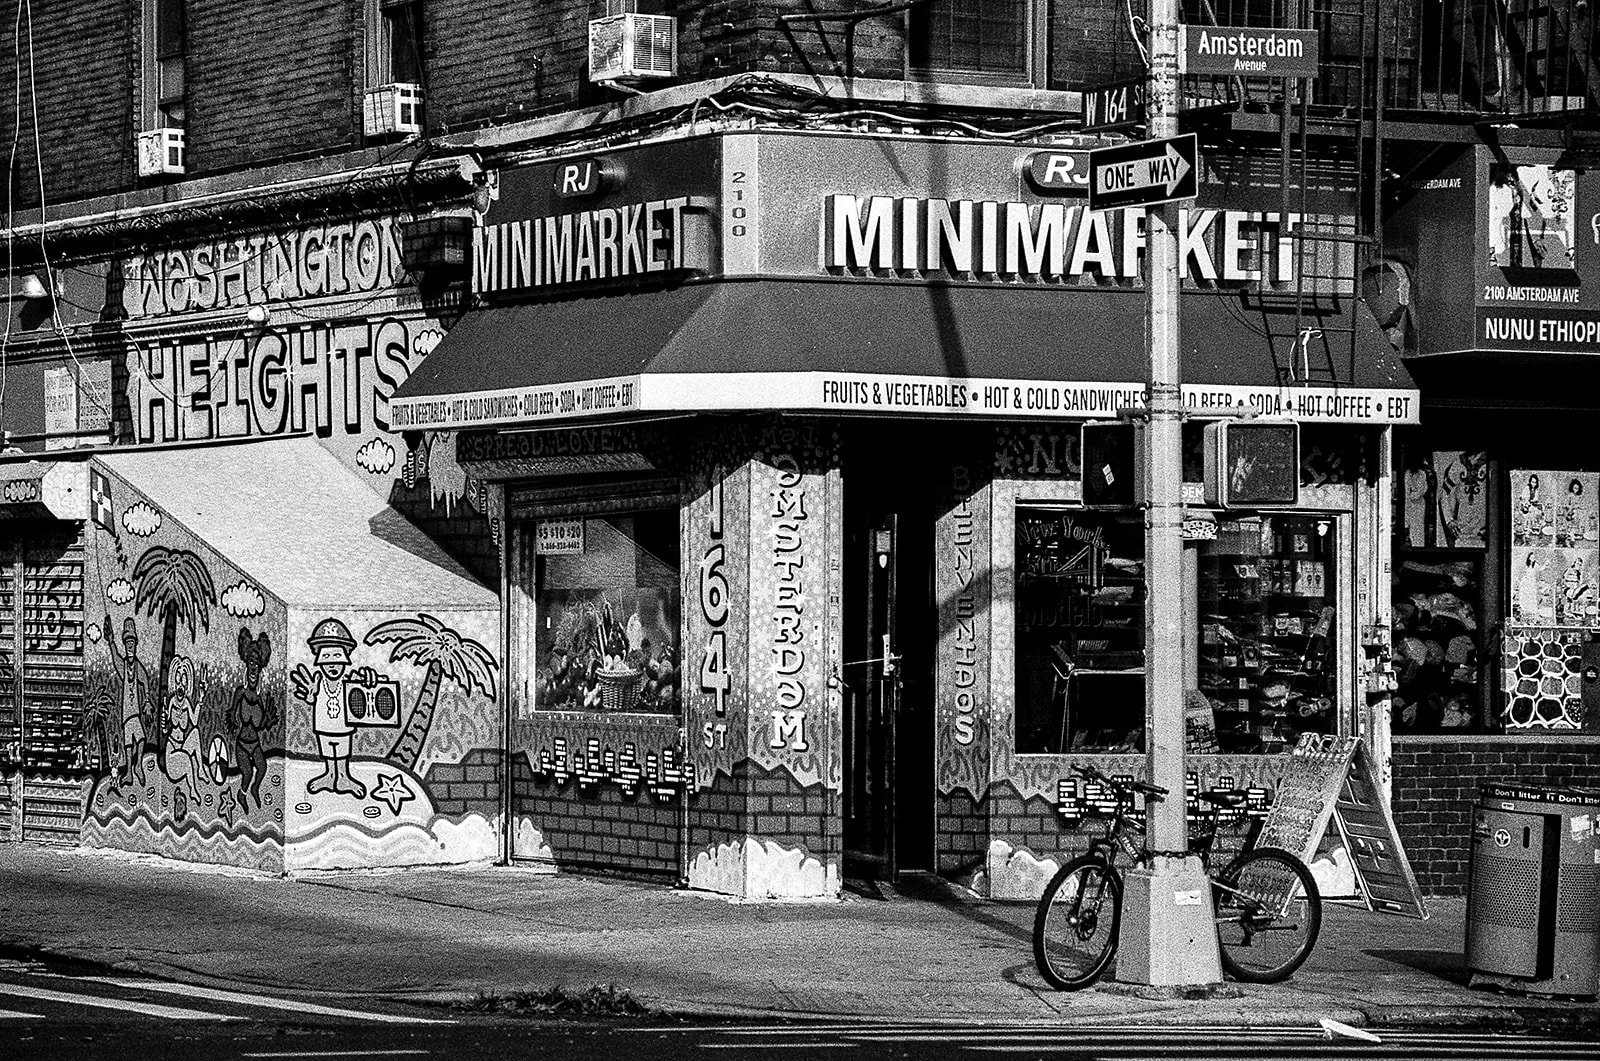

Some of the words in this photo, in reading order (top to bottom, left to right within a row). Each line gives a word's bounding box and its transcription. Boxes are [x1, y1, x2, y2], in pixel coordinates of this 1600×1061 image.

[1198, 30, 1303, 58] Amsterdam
[1233, 58, 1267, 71] Avenue
[1086, 91, 1098, 127] W
[1104, 86, 1127, 124] 164
[562, 163, 591, 194] RJ
[1105, 164, 1135, 190] ONE
[1149, 157, 1180, 184] WAY
[731, 171, 744, 237] 2100
[472, 197, 688, 293] MINIMARKET
[1484, 285, 1504, 300] 2100
[1506, 286, 1561, 302] AMSTERDAM
[1562, 288, 1580, 303] AVE
[1485, 317, 1534, 341] NUNU
[136, 317, 409, 444] HEIGHTS
[469, 398, 483, 420] COLD
[524, 393, 539, 416] COLD
[540, 392, 553, 414] BEER
[560, 390, 576, 413] SODA
[582, 387, 594, 410] HOT
[595, 385, 616, 409] COFFEE
[622, 383, 634, 406] EBT
[823, 380, 869, 404] FRUITS
[873, 382, 883, 405] &
[886, 383, 967, 408] VEGETABLES
[984, 386, 1010, 409] HOT
[1013, 387, 1023, 409] &
[1027, 388, 1060, 411] COLD
[1249, 394, 1282, 415] SODA
[1298, 395, 1323, 417] HOT
[1326, 396, 1372, 418] COFFEE
[1388, 398, 1411, 419] EBT
[703, 721, 728, 750] ST
[1494, 788, 1515, 798] Don't
[1558, 794, 1582, 804] Don't
